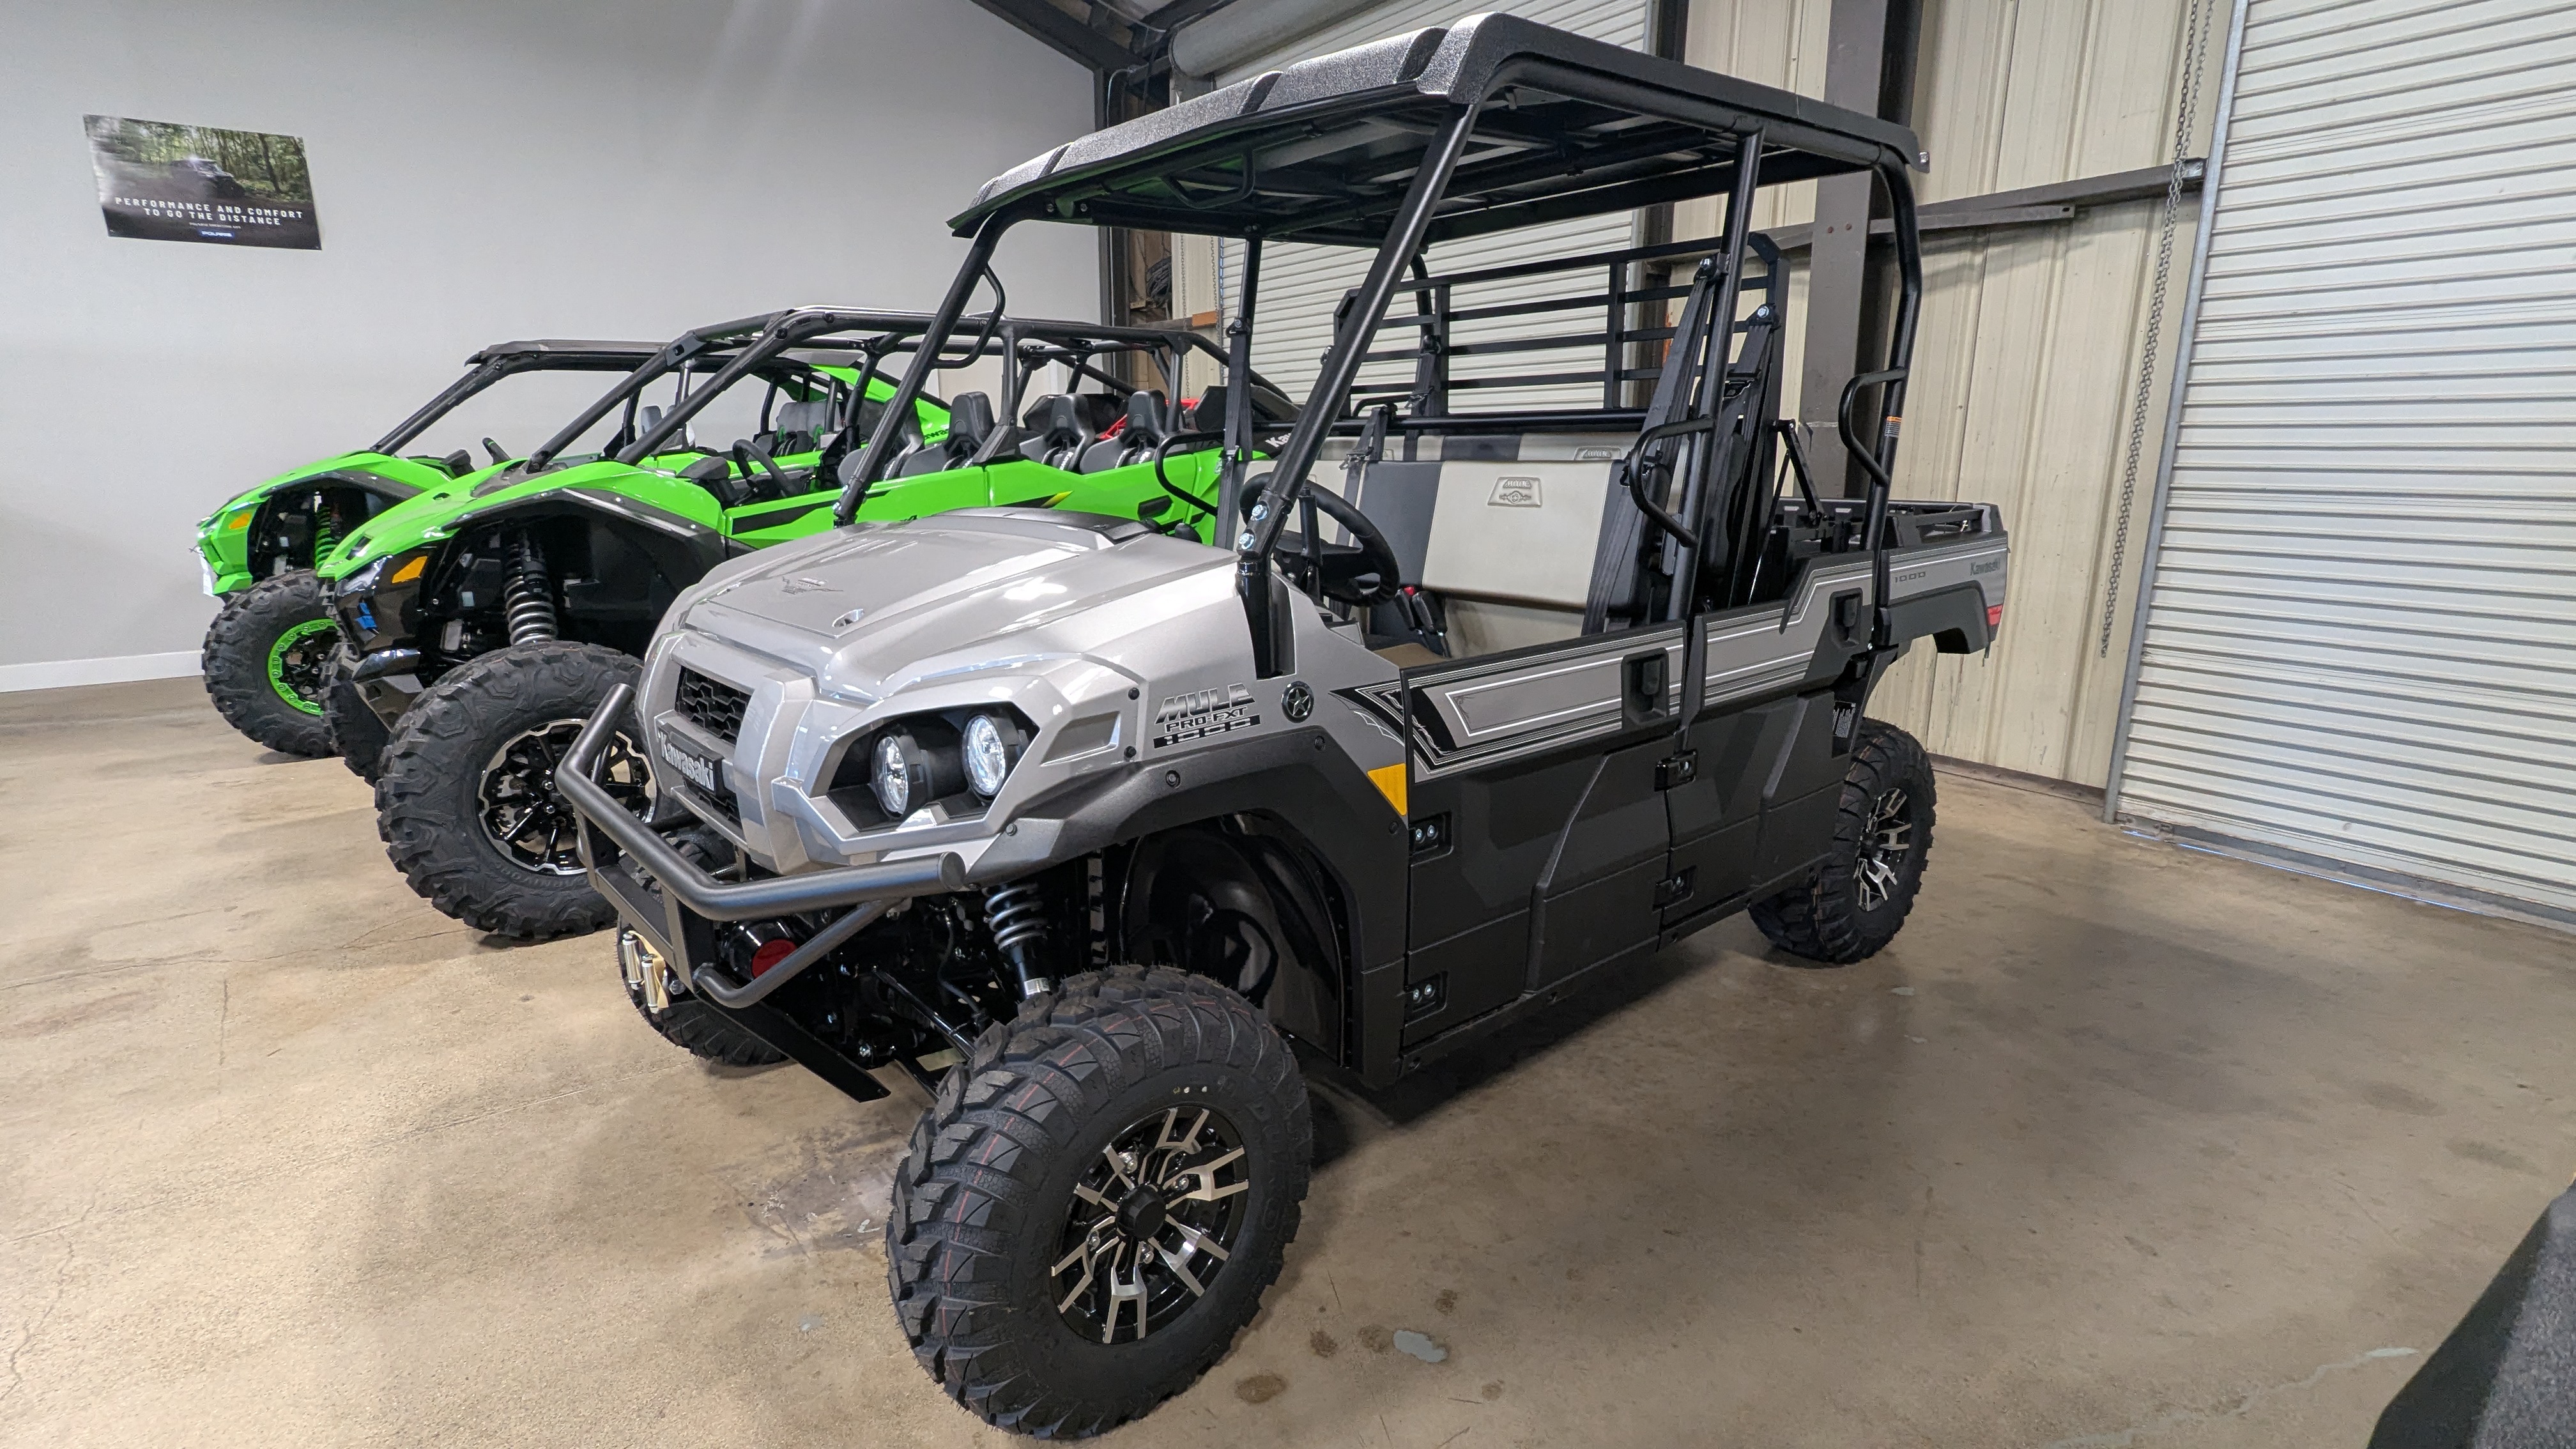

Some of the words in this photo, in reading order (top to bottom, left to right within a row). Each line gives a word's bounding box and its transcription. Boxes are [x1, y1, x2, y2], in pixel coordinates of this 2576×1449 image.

[115, 197, 211, 212] PERFORMANCE
[217, 204, 241, 214] AND
[247, 207, 303, 218] COMFORT
[143, 208, 160, 217] TO
[167, 210, 183, 218] GO
[188, 211, 213, 220] THE
[219, 213, 280, 226] DISTANCE
[1154, 682, 1255, 724] MULE
[1163, 717, 1252, 746] 1000
[1165, 707, 1247, 733] PRO-FXT
[660, 730, 715, 792] Kawasaki
